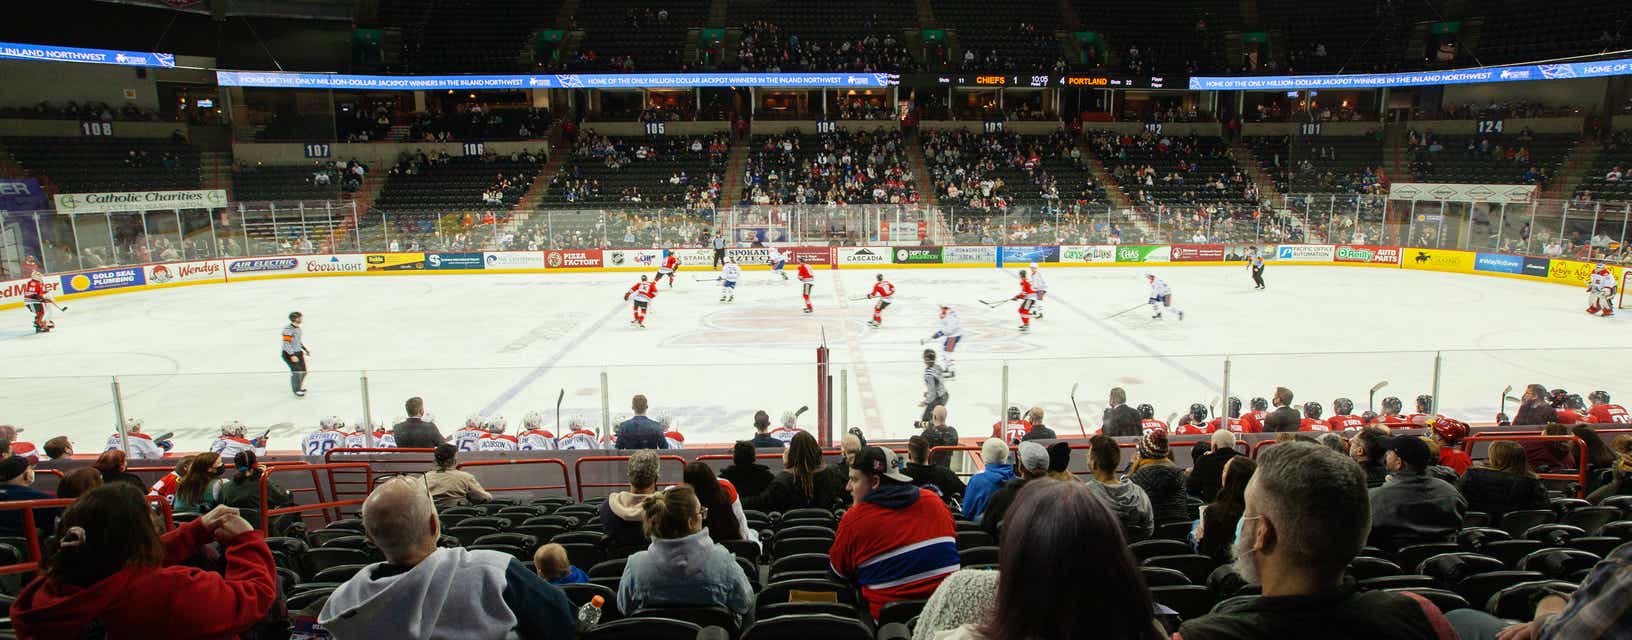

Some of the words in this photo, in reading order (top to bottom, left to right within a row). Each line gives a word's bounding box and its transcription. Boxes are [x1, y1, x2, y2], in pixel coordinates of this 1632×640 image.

[5, 47, 45, 57] INLAND
[45, 50, 107, 61] NORTHWEST
[1583, 66, 1611, 74] HOME
[976, 76, 1006, 85] CHIEFS
[1013, 76, 1018, 85] 1
[1031, 76, 1049, 84] 10:05
[1060, 76, 1066, 85] 4
[1068, 76, 1108, 86] PORTLAND
[1442, 72, 1492, 81] NORTHWEST
[82, 123, 112, 136] 108
[646, 123, 665, 135] 105
[816, 121, 835, 133] 104
[1145, 124, 1162, 135] 102
[1302, 123, 1320, 135] 101
[1479, 120, 1504, 133] 124
[306, 144, 330, 157] 107
[463, 143, 484, 156] 106
[86, 192, 141, 204] Catholic
[145, 190, 203, 202] Charities
[1121, 248, 1140, 258] CHAS
[253, 258, 295, 267] ELECTRIC
[306, 260, 336, 272] Coors
[336, 264, 362, 272] LIGHT
[92, 272, 115, 280] GOLD
[116, 270, 136, 278] SEAL
[179, 262, 220, 278] Wendy's
[1550, 267, 1572, 277] Arby's
[93, 276, 134, 286] PLUMBING
